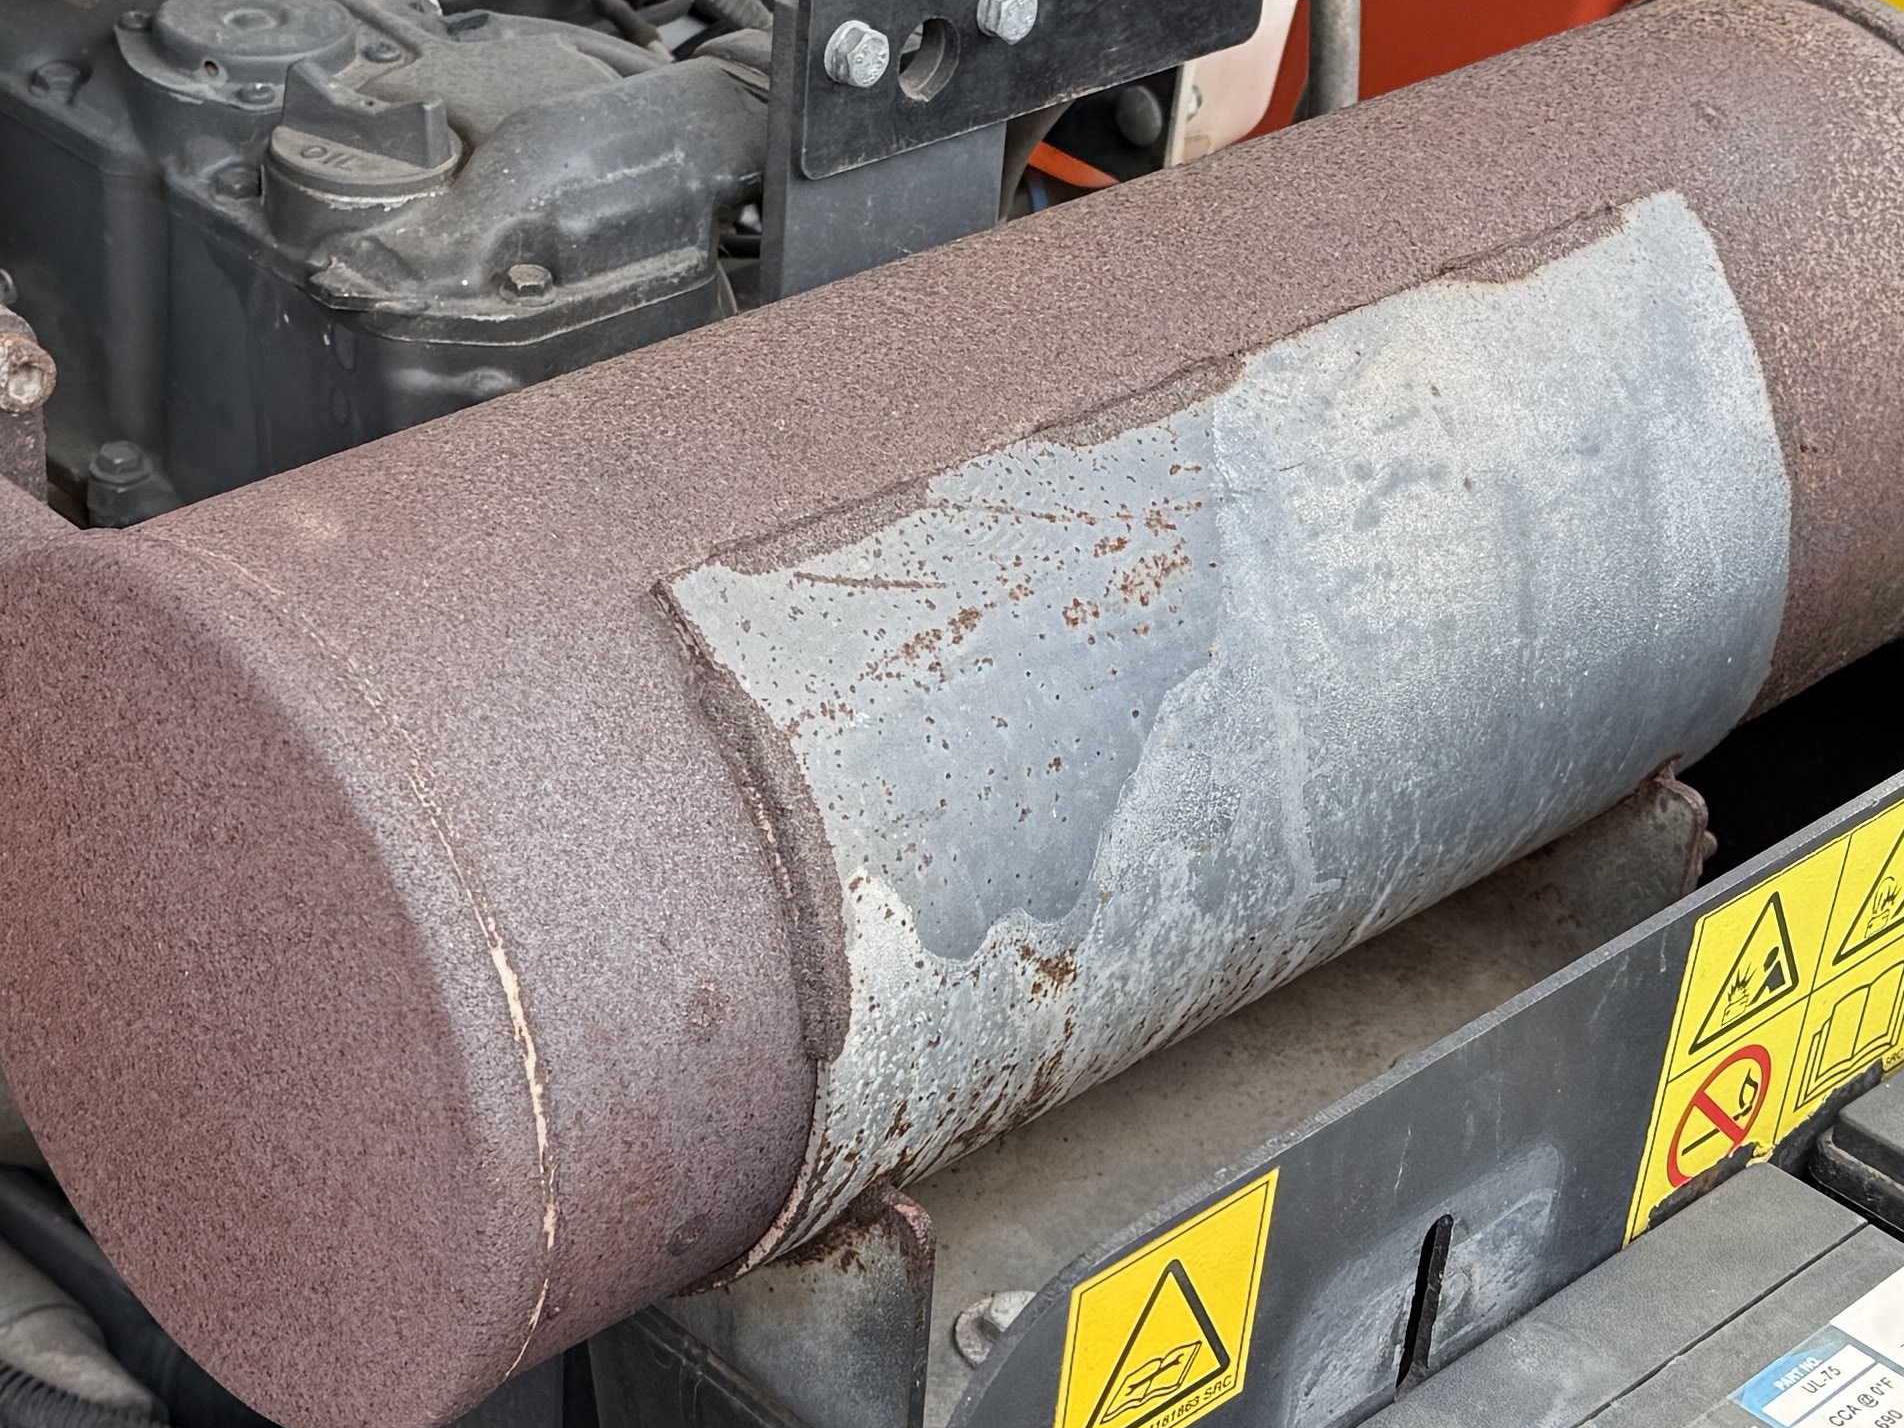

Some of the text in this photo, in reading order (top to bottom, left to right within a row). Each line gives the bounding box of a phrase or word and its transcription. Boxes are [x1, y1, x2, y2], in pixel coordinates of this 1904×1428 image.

[299, 144, 359, 172] OIL
[1772, 1367, 1801, 1392] PART
[1801, 1365, 1842, 1394] UL-75
[1828, 1403, 1863, 1428] CCA
